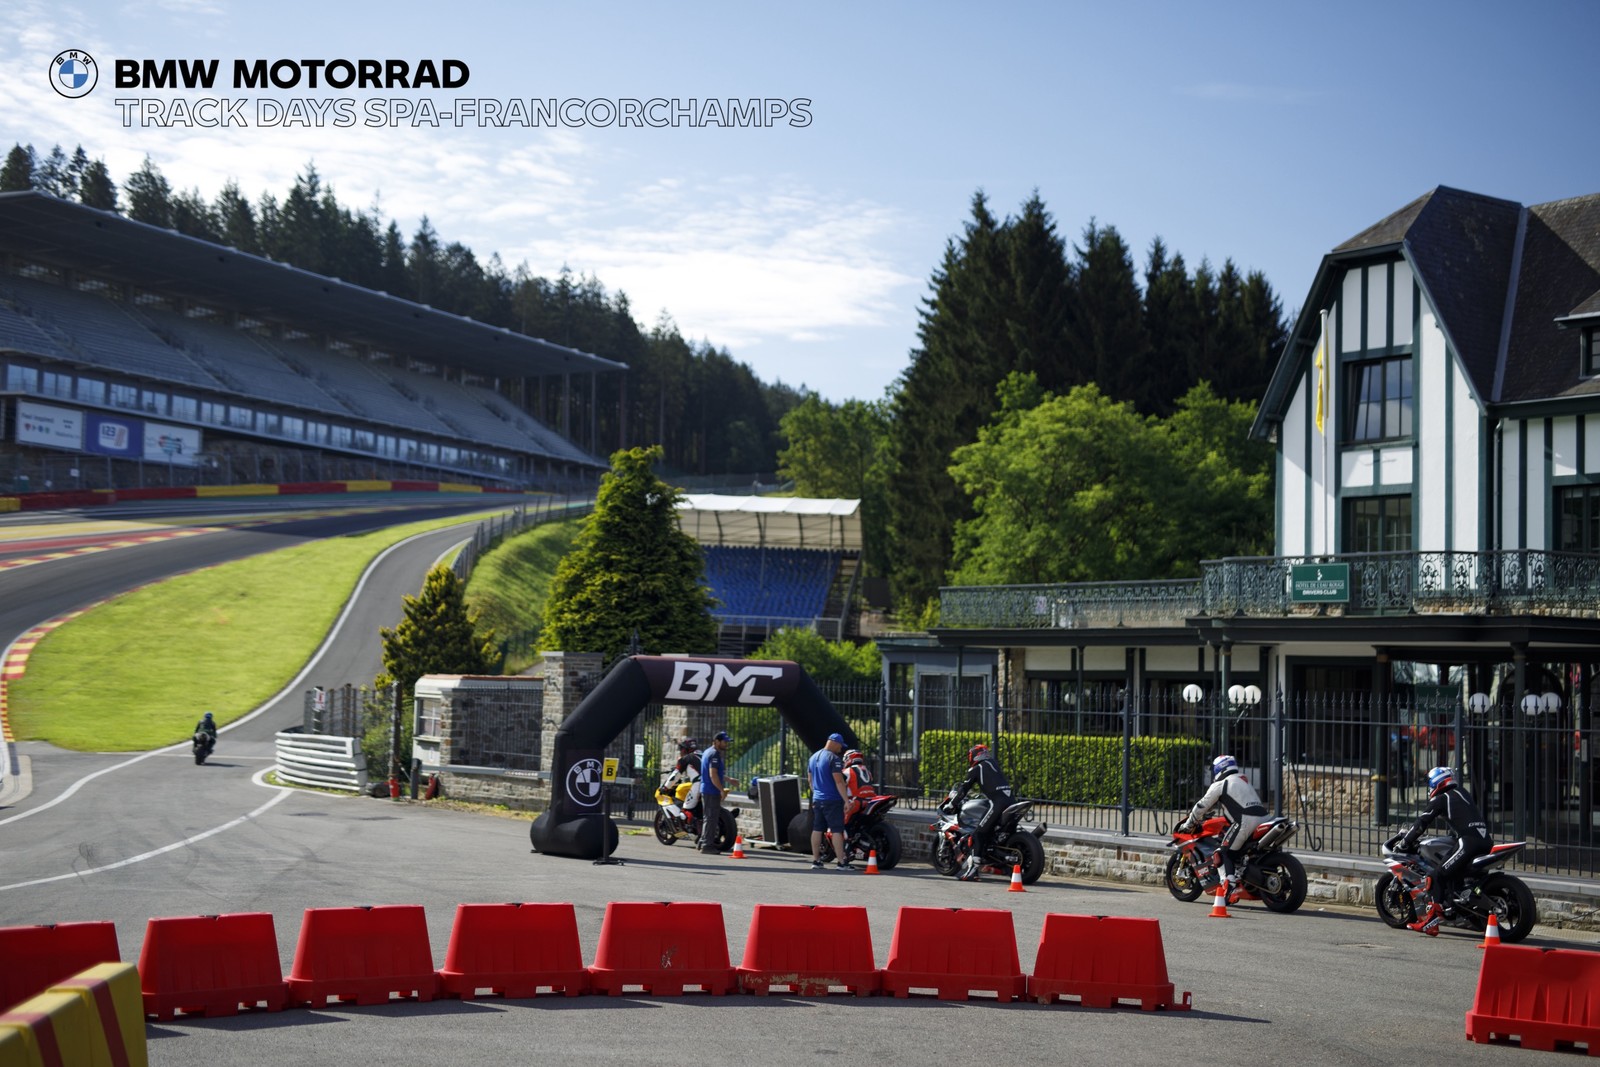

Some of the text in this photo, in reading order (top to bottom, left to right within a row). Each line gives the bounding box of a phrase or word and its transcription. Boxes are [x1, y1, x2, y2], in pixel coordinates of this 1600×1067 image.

[102, 425, 117, 437] 123
[665, 661, 782, 704] BMC
[606, 767, 614, 777] B
